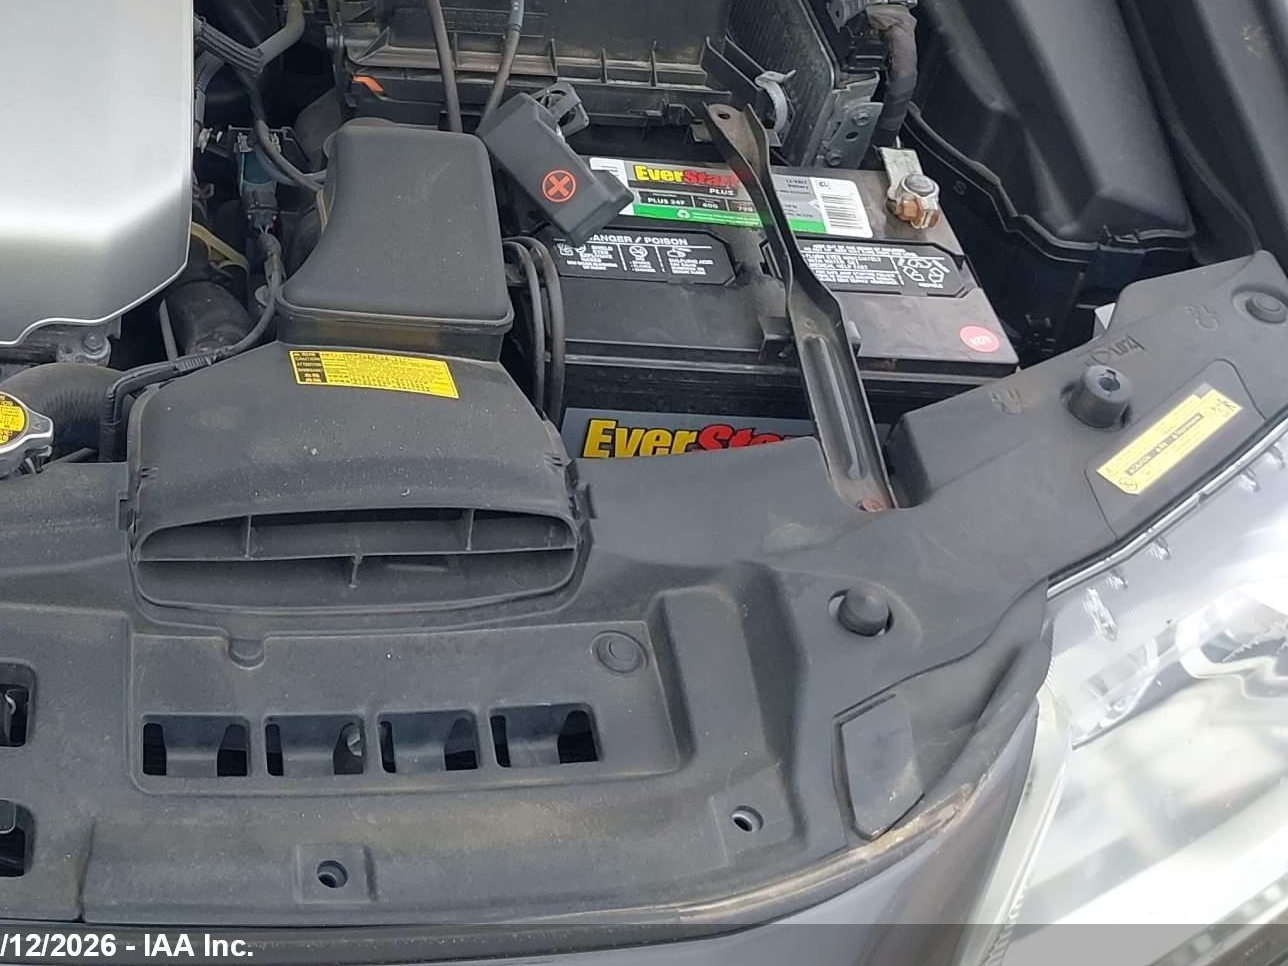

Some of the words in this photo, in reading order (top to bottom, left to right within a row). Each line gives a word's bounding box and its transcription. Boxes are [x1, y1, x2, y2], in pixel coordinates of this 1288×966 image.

[709, 187, 735, 196] PLUS
[588, 233, 633, 244] ANGER
[643, 236, 689, 246] POISON
